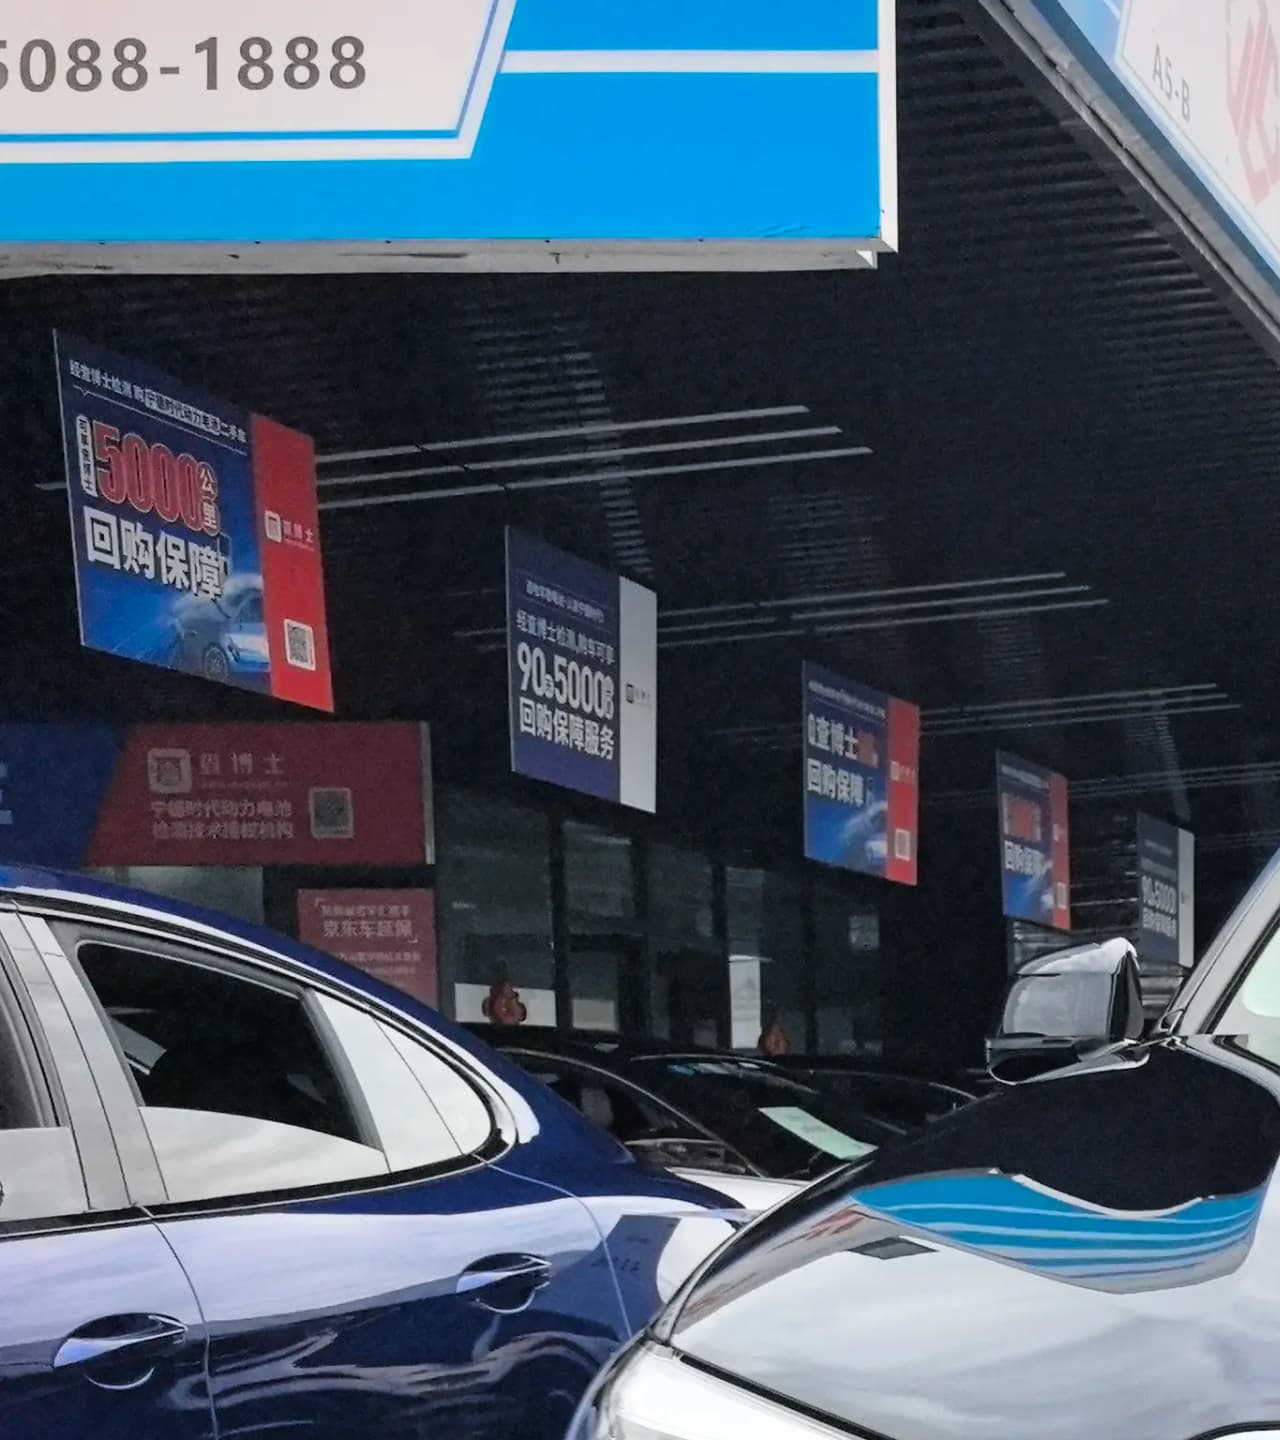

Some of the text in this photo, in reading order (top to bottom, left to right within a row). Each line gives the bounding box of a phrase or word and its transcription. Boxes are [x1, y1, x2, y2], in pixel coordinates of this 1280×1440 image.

[0, 35, 367, 93] 088-1888
[1152, 43, 1191, 123] A5-B
[83, 505, 223, 602] 回购保障
[519, 696, 615, 761] 回购保障服务
[807, 757, 865, 807] 回购保障
